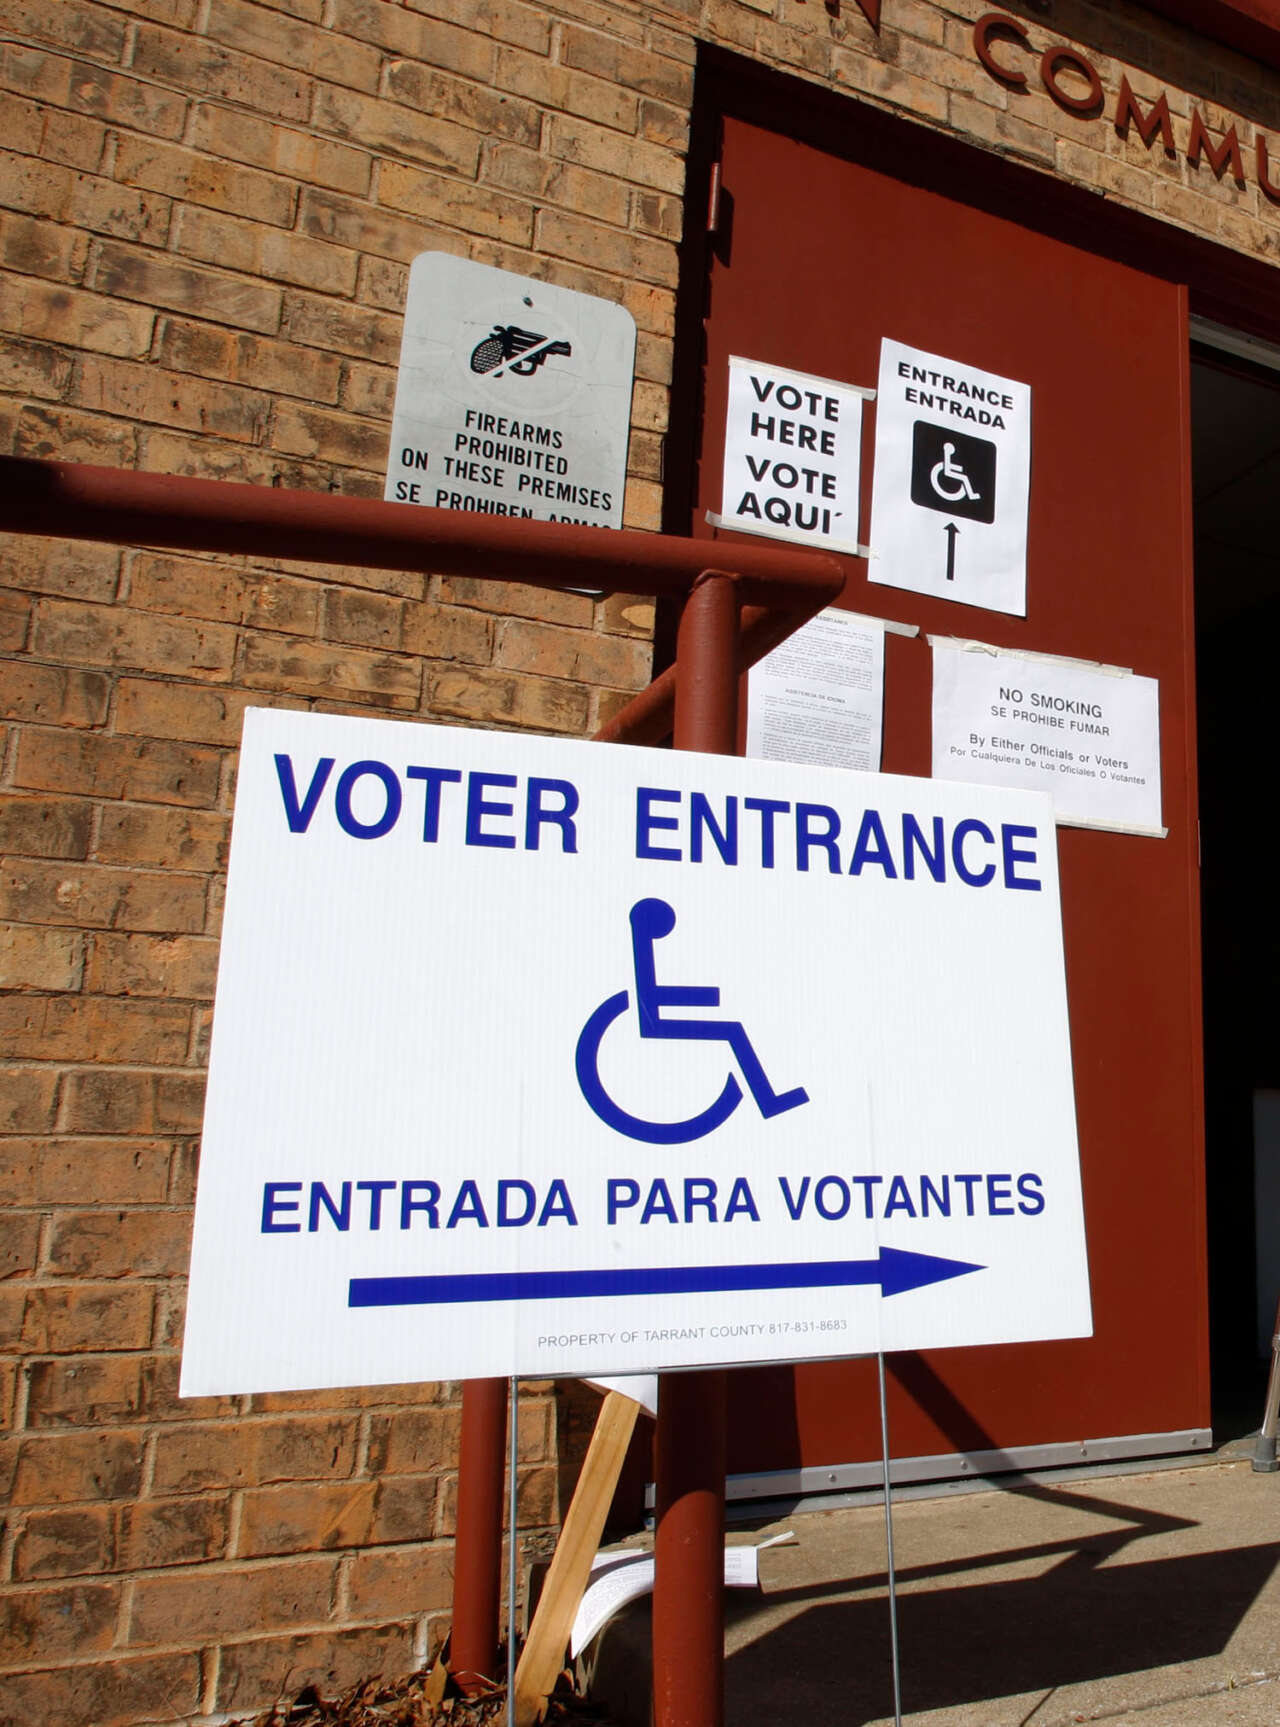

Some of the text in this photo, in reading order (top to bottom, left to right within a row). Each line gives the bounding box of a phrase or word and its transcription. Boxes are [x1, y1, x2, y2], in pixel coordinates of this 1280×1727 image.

[750, 376, 840, 423] VOTE
[898, 361, 1014, 411] ENTRANCE
[465, 409, 564, 450] FIREARMS
[905, 387, 1006, 430] ENTRADA
[454, 433, 569, 476] PROHIBITED
[750, 412, 836, 457] HERE
[395, 480, 422, 504] SE
[401, 447, 613, 511] ON THESE PREMISES
[745, 455, 837, 500] VOTE
[990, 705, 1111, 737] SE PROHIBE FUMAR
[999, 686, 1103, 719] NO SMOKING
[950, 746, 1147, 785] Por Cualquiera De Los Oficiales O Votantes
[969, 733, 1129, 770] By Either Officials or Voters
[273, 753, 1042, 892] VOTER ENTRANCE
[260, 1172, 1046, 1234] ENTRADA PARA VOTANTES
[537, 1319, 848, 1348] PROPERTY OF TARRANT COUNTY 817-831-8683
